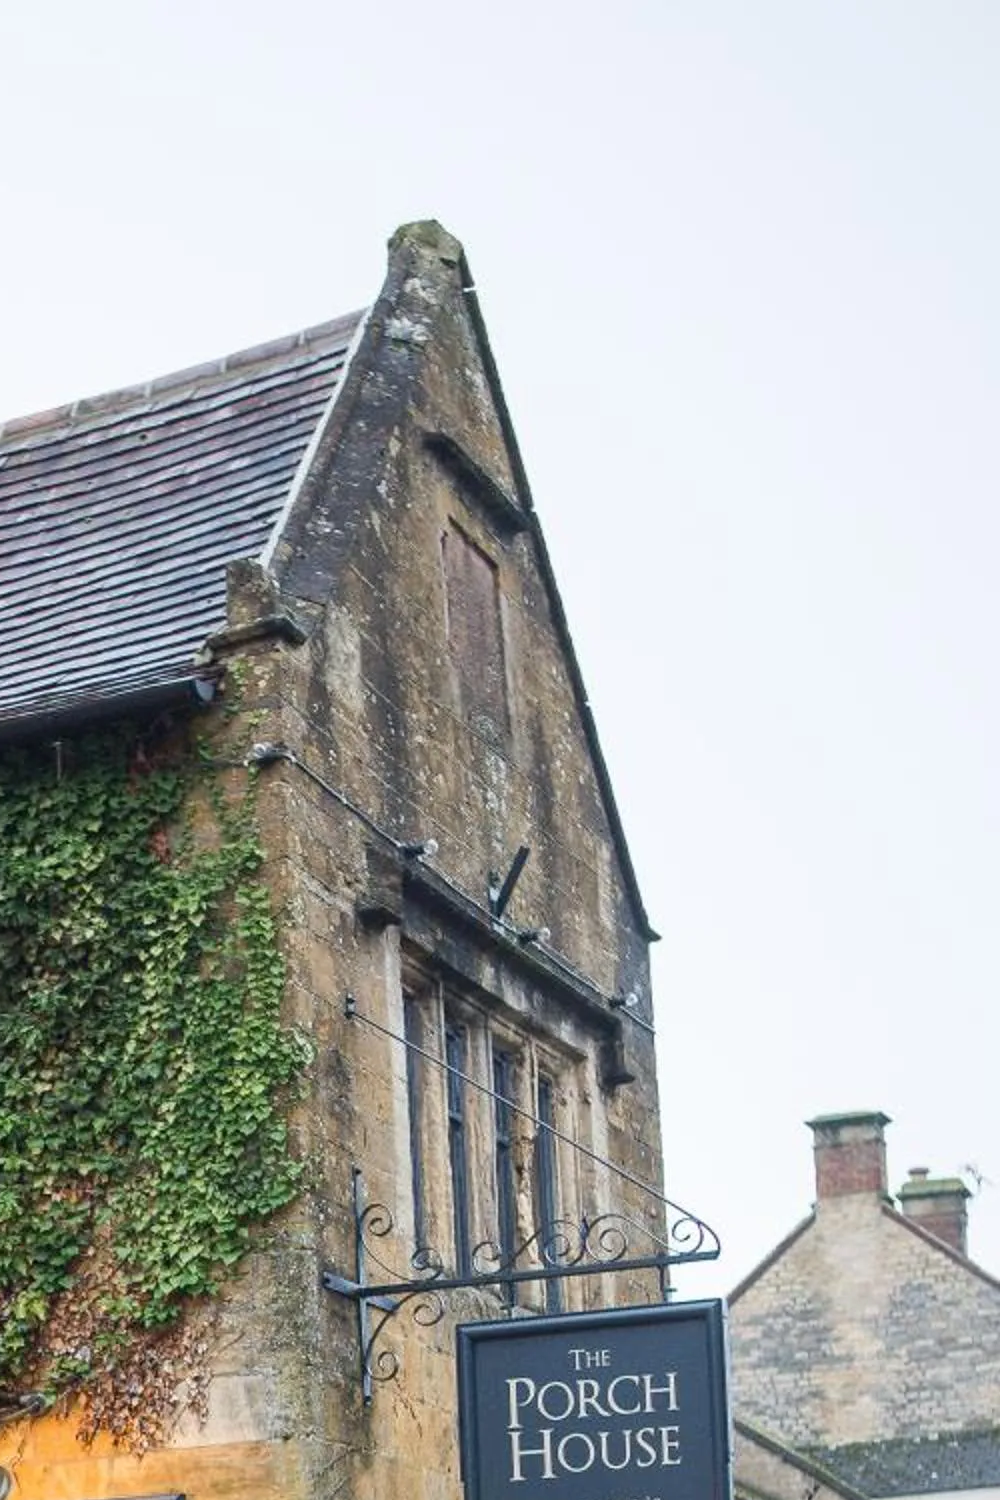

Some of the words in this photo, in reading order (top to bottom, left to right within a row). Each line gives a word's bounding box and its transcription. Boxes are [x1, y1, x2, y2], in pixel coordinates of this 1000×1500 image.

[568, 1349, 611, 1371] THE
[505, 1372, 680, 1429] PORCH
[508, 1425, 682, 1482] HOUSE
